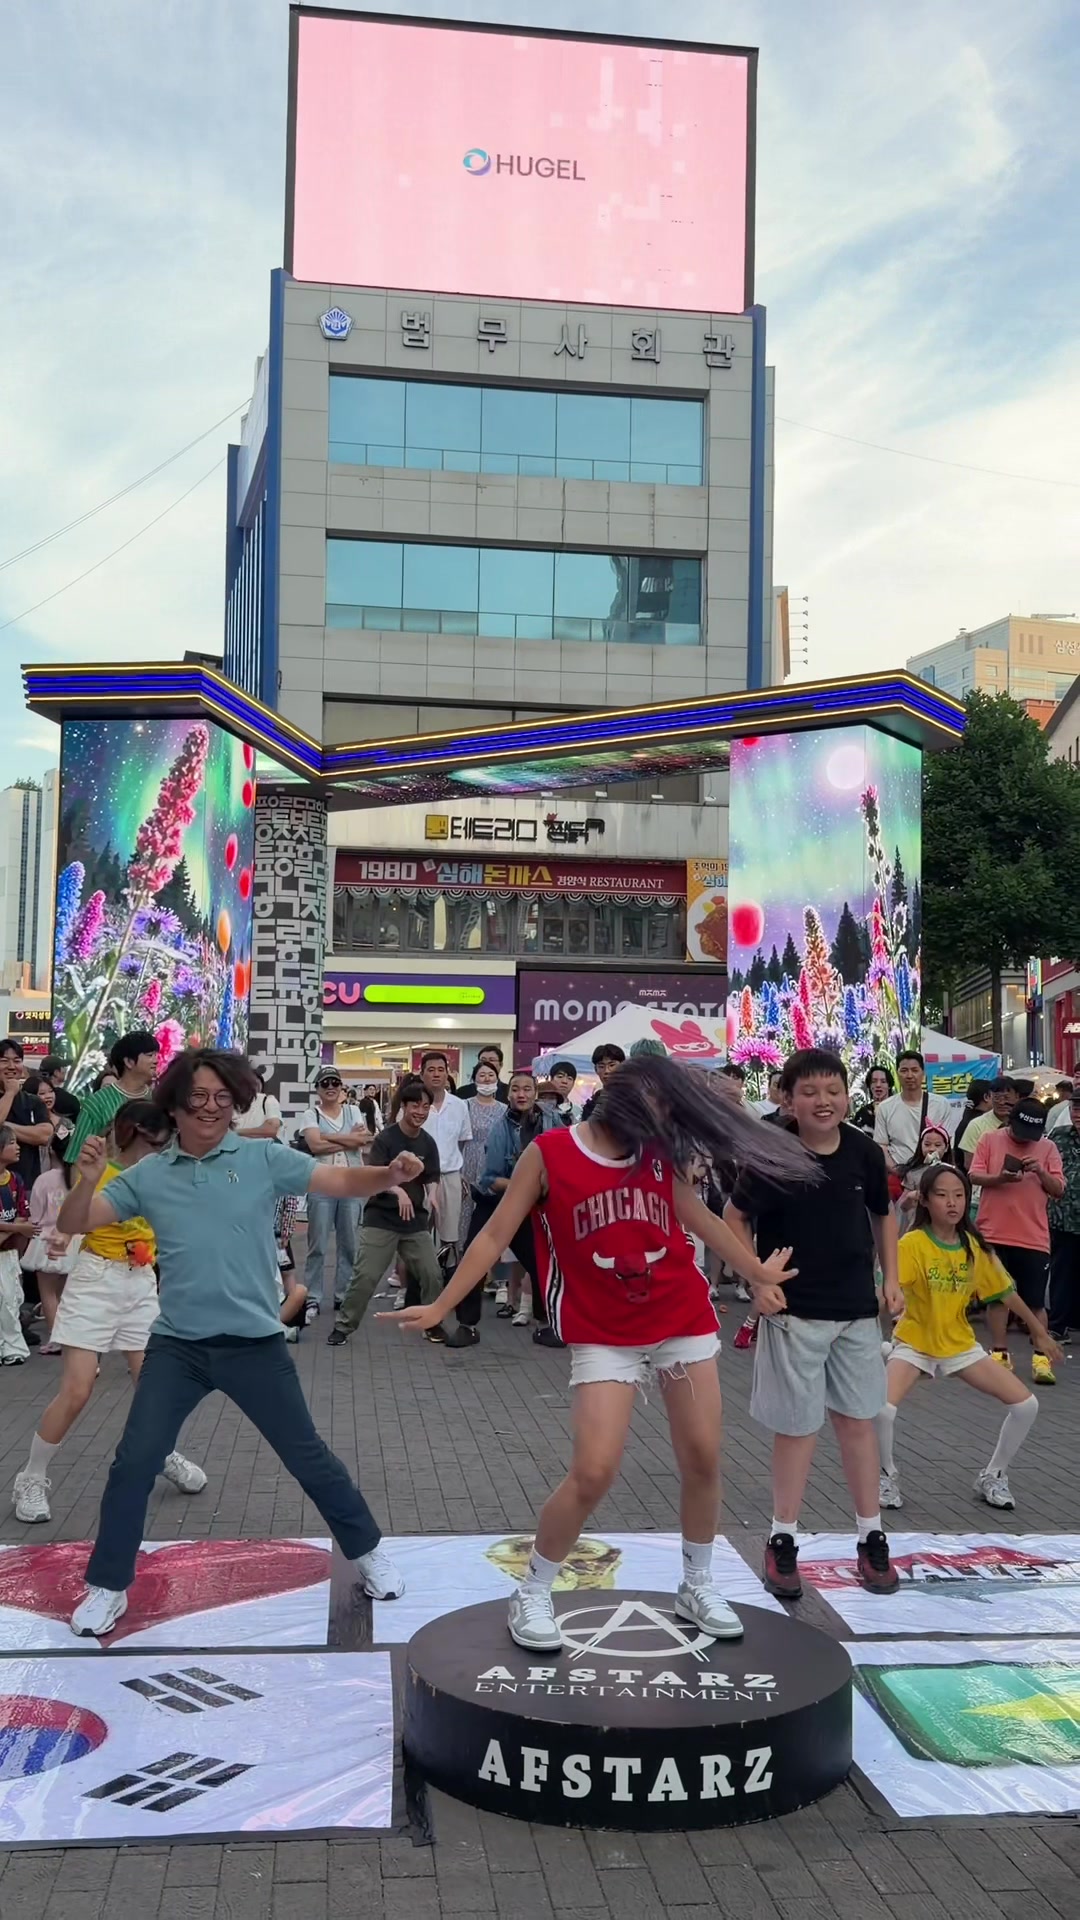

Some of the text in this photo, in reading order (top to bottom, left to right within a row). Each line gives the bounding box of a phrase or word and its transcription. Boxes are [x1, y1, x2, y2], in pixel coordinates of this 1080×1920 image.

[496, 154, 586, 182] HUGEL
[401, 310, 735, 369] 법무사회관
[359, 860, 417, 881] 1980
[436, 862, 552, 886] 심해돈까스
[589, 876, 664, 889] RESTAURANT
[323, 981, 361, 1005] CU
[573, 1187, 670, 1240] CHICAGO
[477, 1665, 777, 1688] AFSTARZ
[475, 1682, 779, 1702] ENTERTAINMENT
[478, 1738, 773, 1802] AFSTARZ
